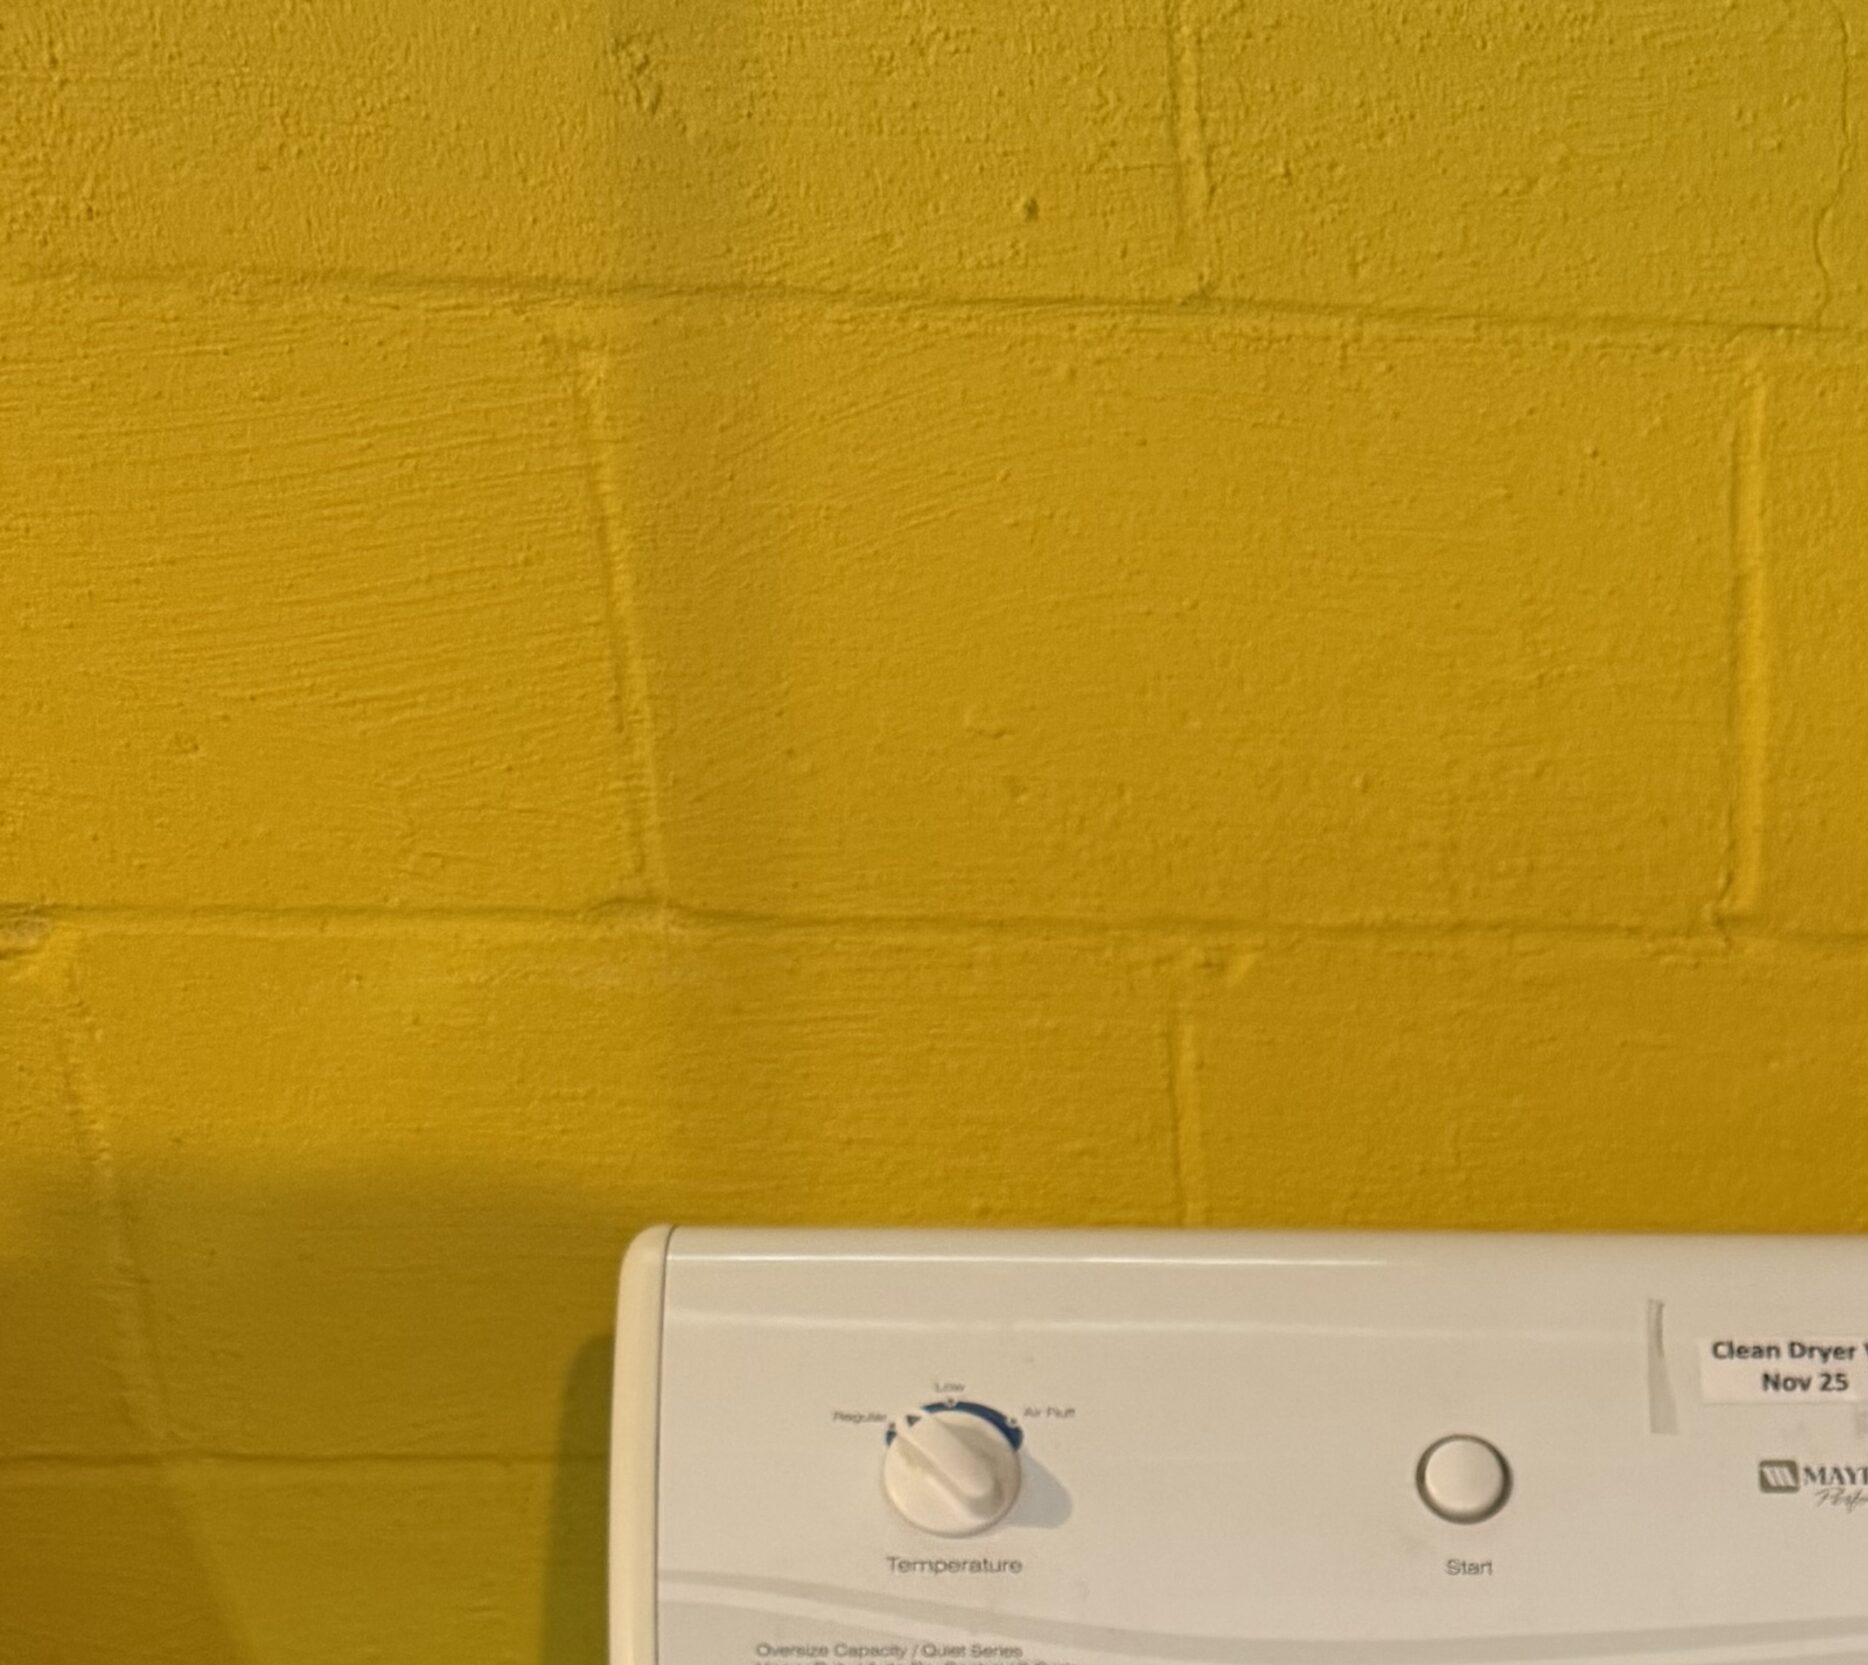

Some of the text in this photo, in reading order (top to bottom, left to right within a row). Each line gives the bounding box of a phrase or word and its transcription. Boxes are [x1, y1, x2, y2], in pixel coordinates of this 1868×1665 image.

[1711, 1340, 1782, 1360] Clean
[1787, 1340, 1857, 1364] Dryer
[1761, 1372, 1849, 1392] Nov 25
[832, 1410, 887, 1424] Regular
[886, 1555, 1024, 1575] Temperature
[1446, 1558, 1493, 1577] Start
[755, 1641, 829, 1658] Oversize
[833, 1642, 907, 1660] Capacity
[921, 1642, 966, 1658] Quiet
[970, 1643, 1023, 1658] Series
